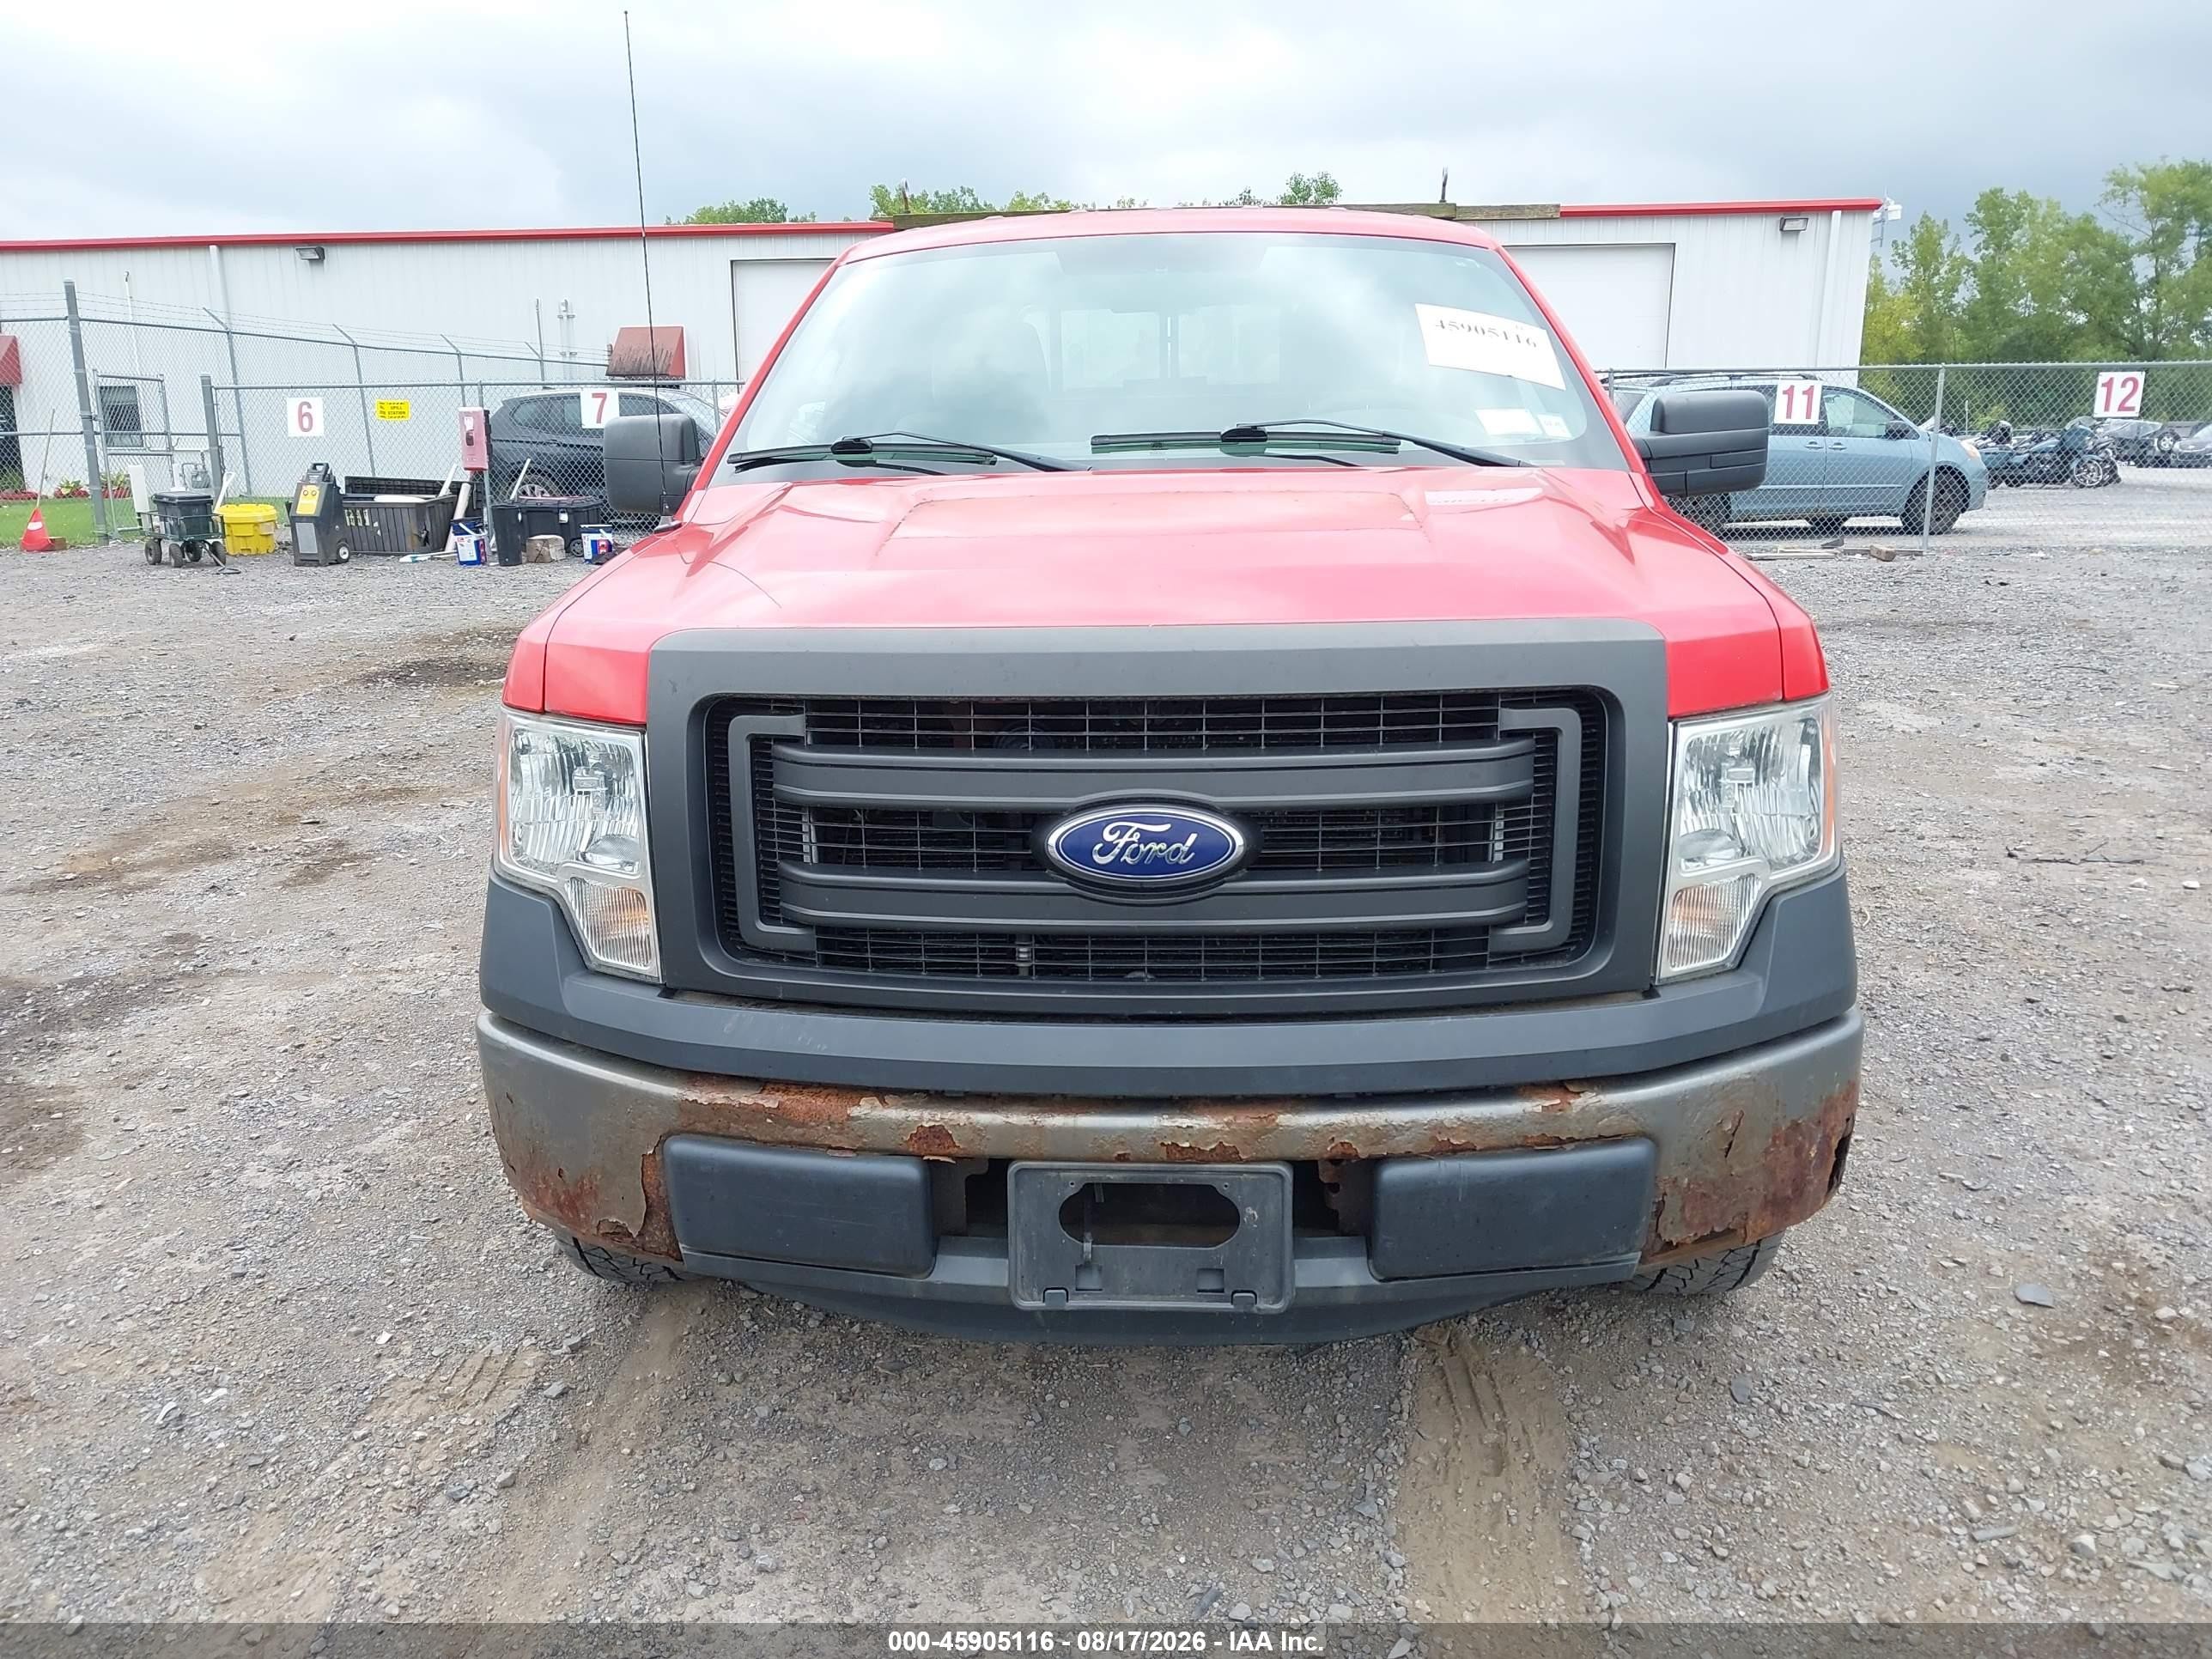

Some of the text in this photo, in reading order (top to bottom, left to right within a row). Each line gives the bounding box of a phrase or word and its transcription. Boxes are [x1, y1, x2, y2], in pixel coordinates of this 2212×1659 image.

[592, 392, 607, 424] 7
[1782, 384, 1814, 420] 11
[2101, 376, 2139, 412] 12
[297, 400, 313, 433] 6
[1092, 821, 1198, 865] Ford
